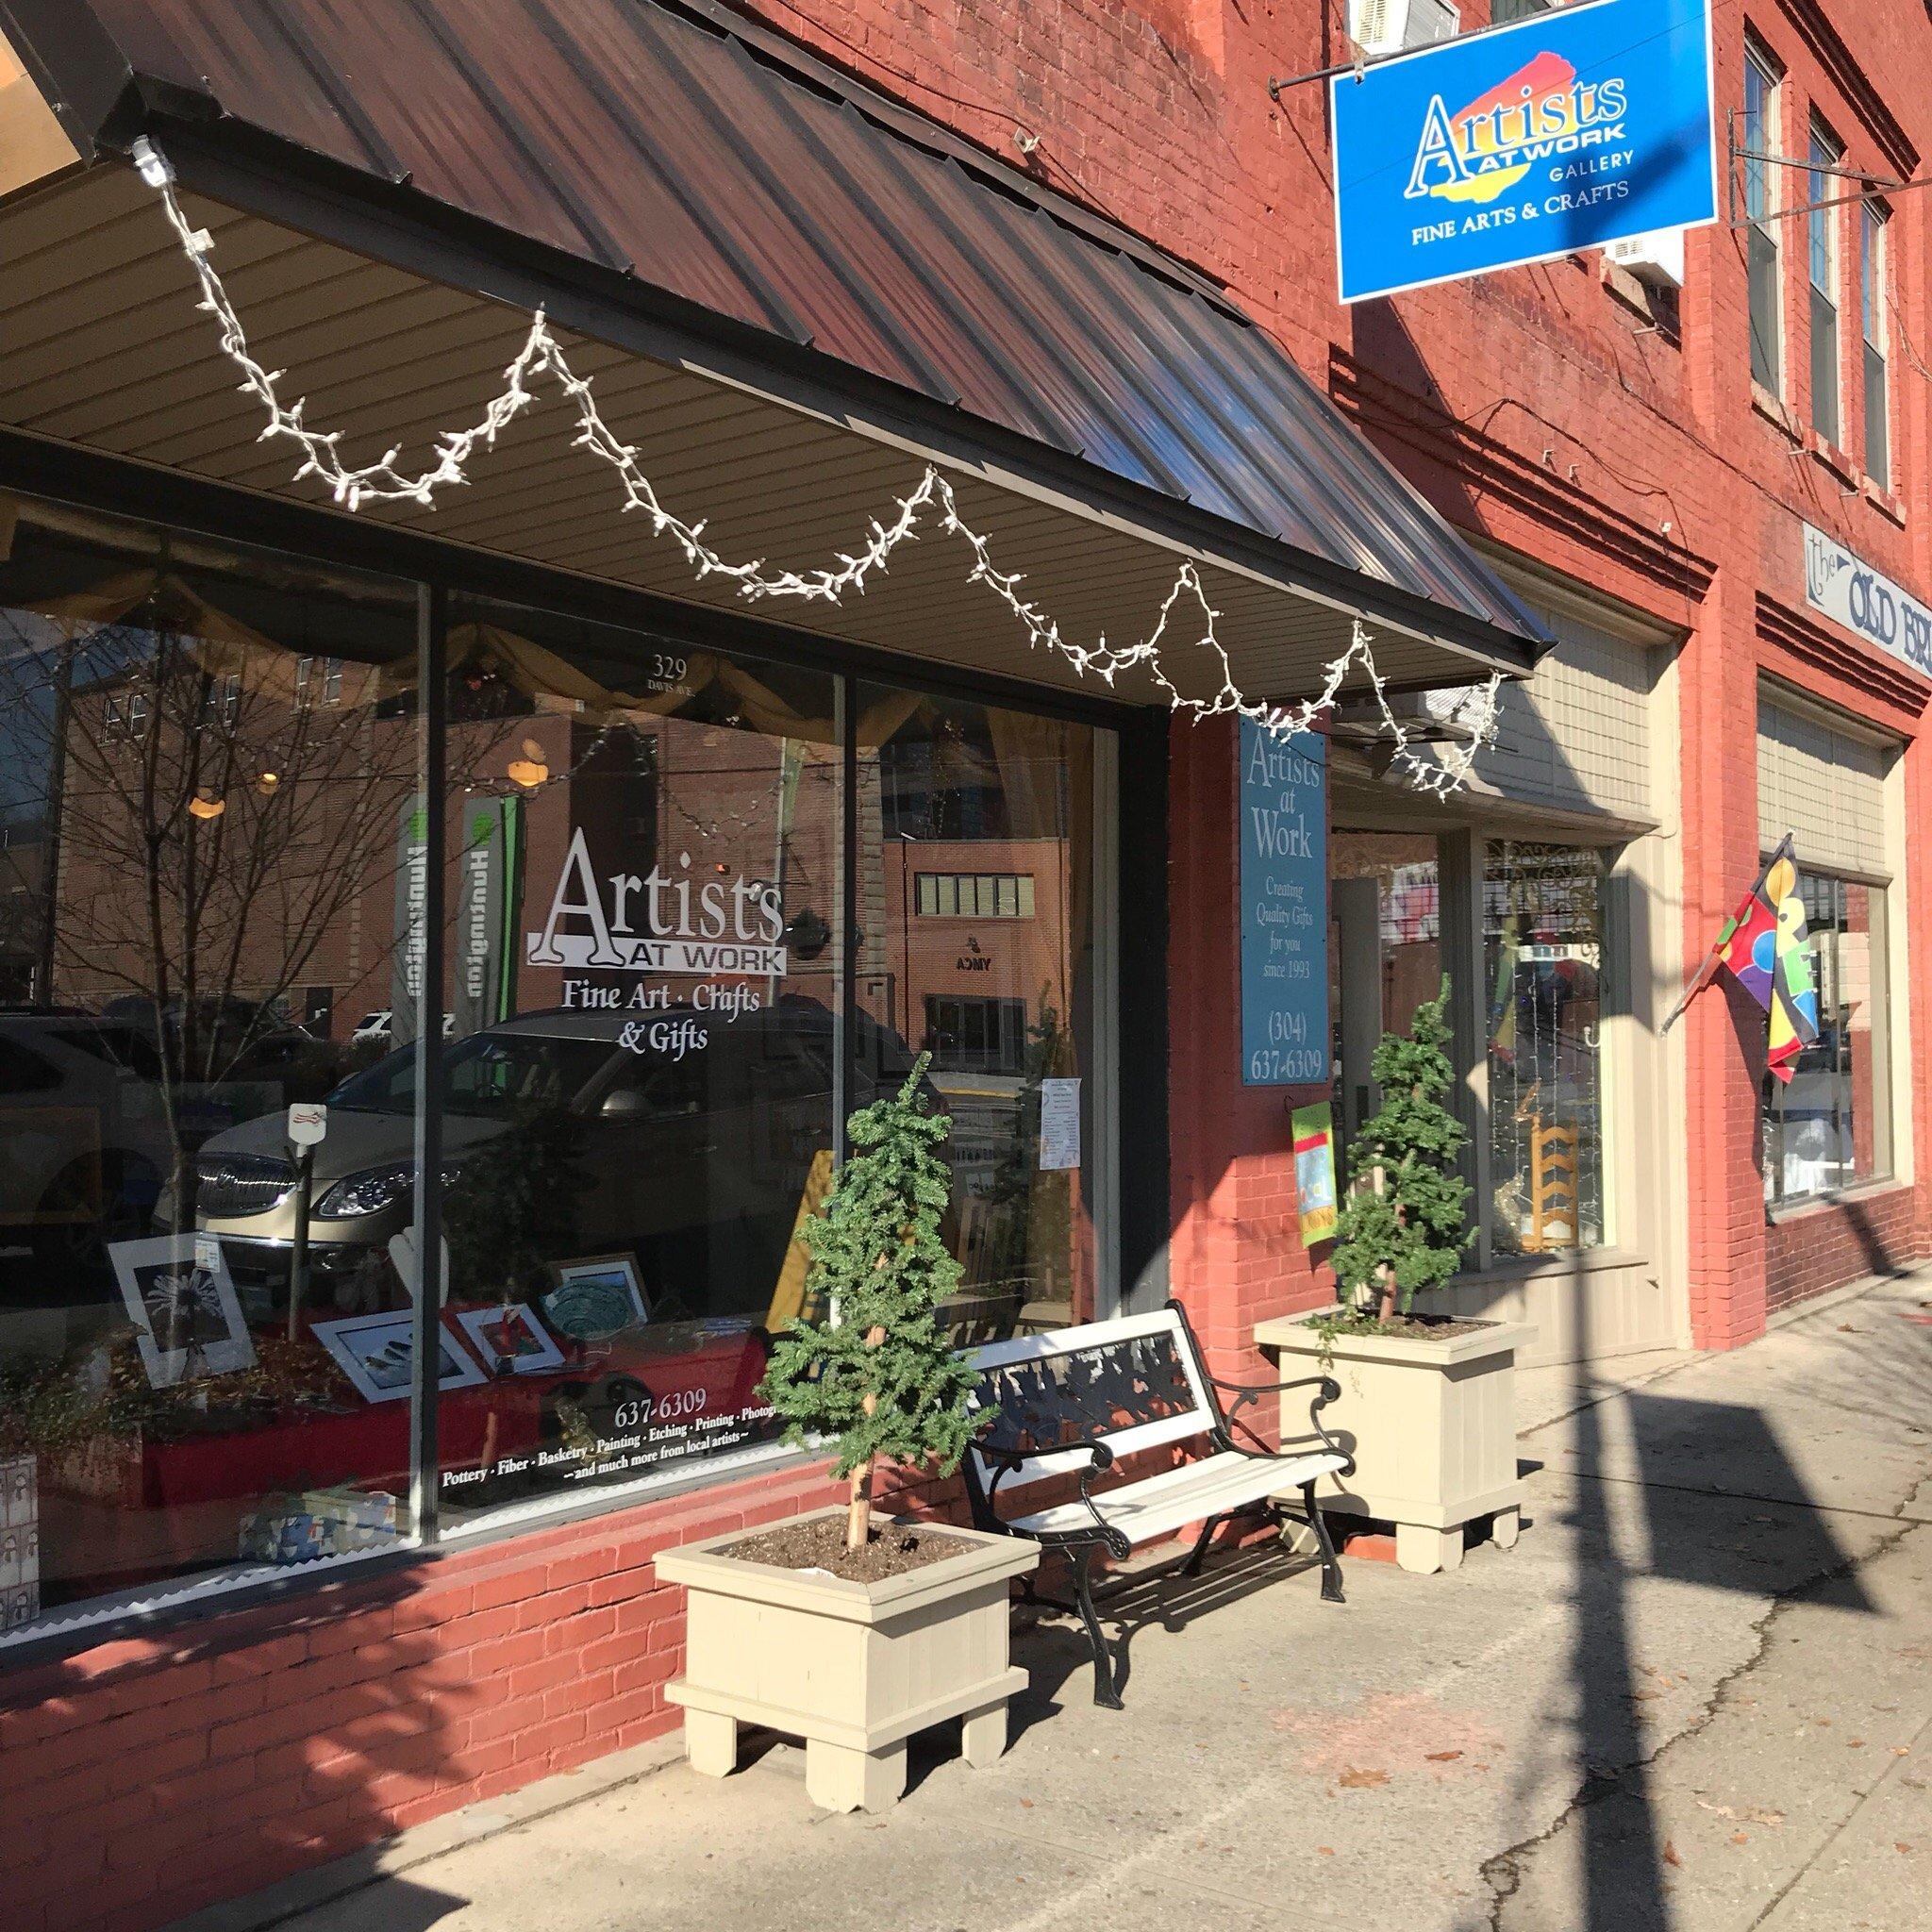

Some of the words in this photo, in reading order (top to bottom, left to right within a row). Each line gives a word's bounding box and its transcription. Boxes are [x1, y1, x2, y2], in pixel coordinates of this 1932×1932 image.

[1404, 78, 1627, 199] Artists
[1478, 150, 1520, 174] AT
[1523, 123, 1626, 160] WORK
[1549, 149, 1634, 182] GALLERY
[1411, 220, 1457, 245] FINE
[1461, 207, 1516, 234] ARTS
[1522, 203, 1540, 220] &
[1544, 180, 1629, 214] CRAFTS
[1807, 533, 1836, 596] the
[1849, 571, 1897, 645] OLD
[653, 654, 688, 681] 329
[1246, 728, 1321, 788] Artists
[1279, 787, 1296, 815] at
[1251, 806, 1313, 859] Work
[528, 826, 784, 967] Artists
[1266, 875, 1305, 903] Creating
[1256, 902, 1291, 929] Quality
[1292, 906, 1314, 930] Gifts
[629, 943, 672, 967] AT
[683, 945, 783, 972] WORK
[1270, 931, 1283, 955] for
[1285, 939, 1301, 956] you
[1263, 959, 1286, 978] since
[1289, 960, 1310, 979] 1993
[561, 979, 623, 1008] Fine
[625, 982, 673, 1009] Art
[692, 982, 760, 1024] Crafts
[617, 1021, 646, 1055] &
[649, 1019, 709, 1062] Gifts
[1269, 1010, 1307, 1045] (304)
[1251, 1049, 1322, 1080] 637-6309
[615, 1388, 707, 1428] 637-6309
[442, 1468, 489, 1488] Pottery
[497, 1457, 529, 1476] Fiber
[538, 1445, 589, 1467] Basketry
[596, 1434, 641, 1454] Painting
[649, 1423, 688, 1442] Etching
[695, 1413, 735, 1432] Printing
[598, 1455, 629, 1475] much
[630, 1451, 658, 1468] more
[660, 1444, 685, 1460] from
[687, 1436, 710, 1454] local
